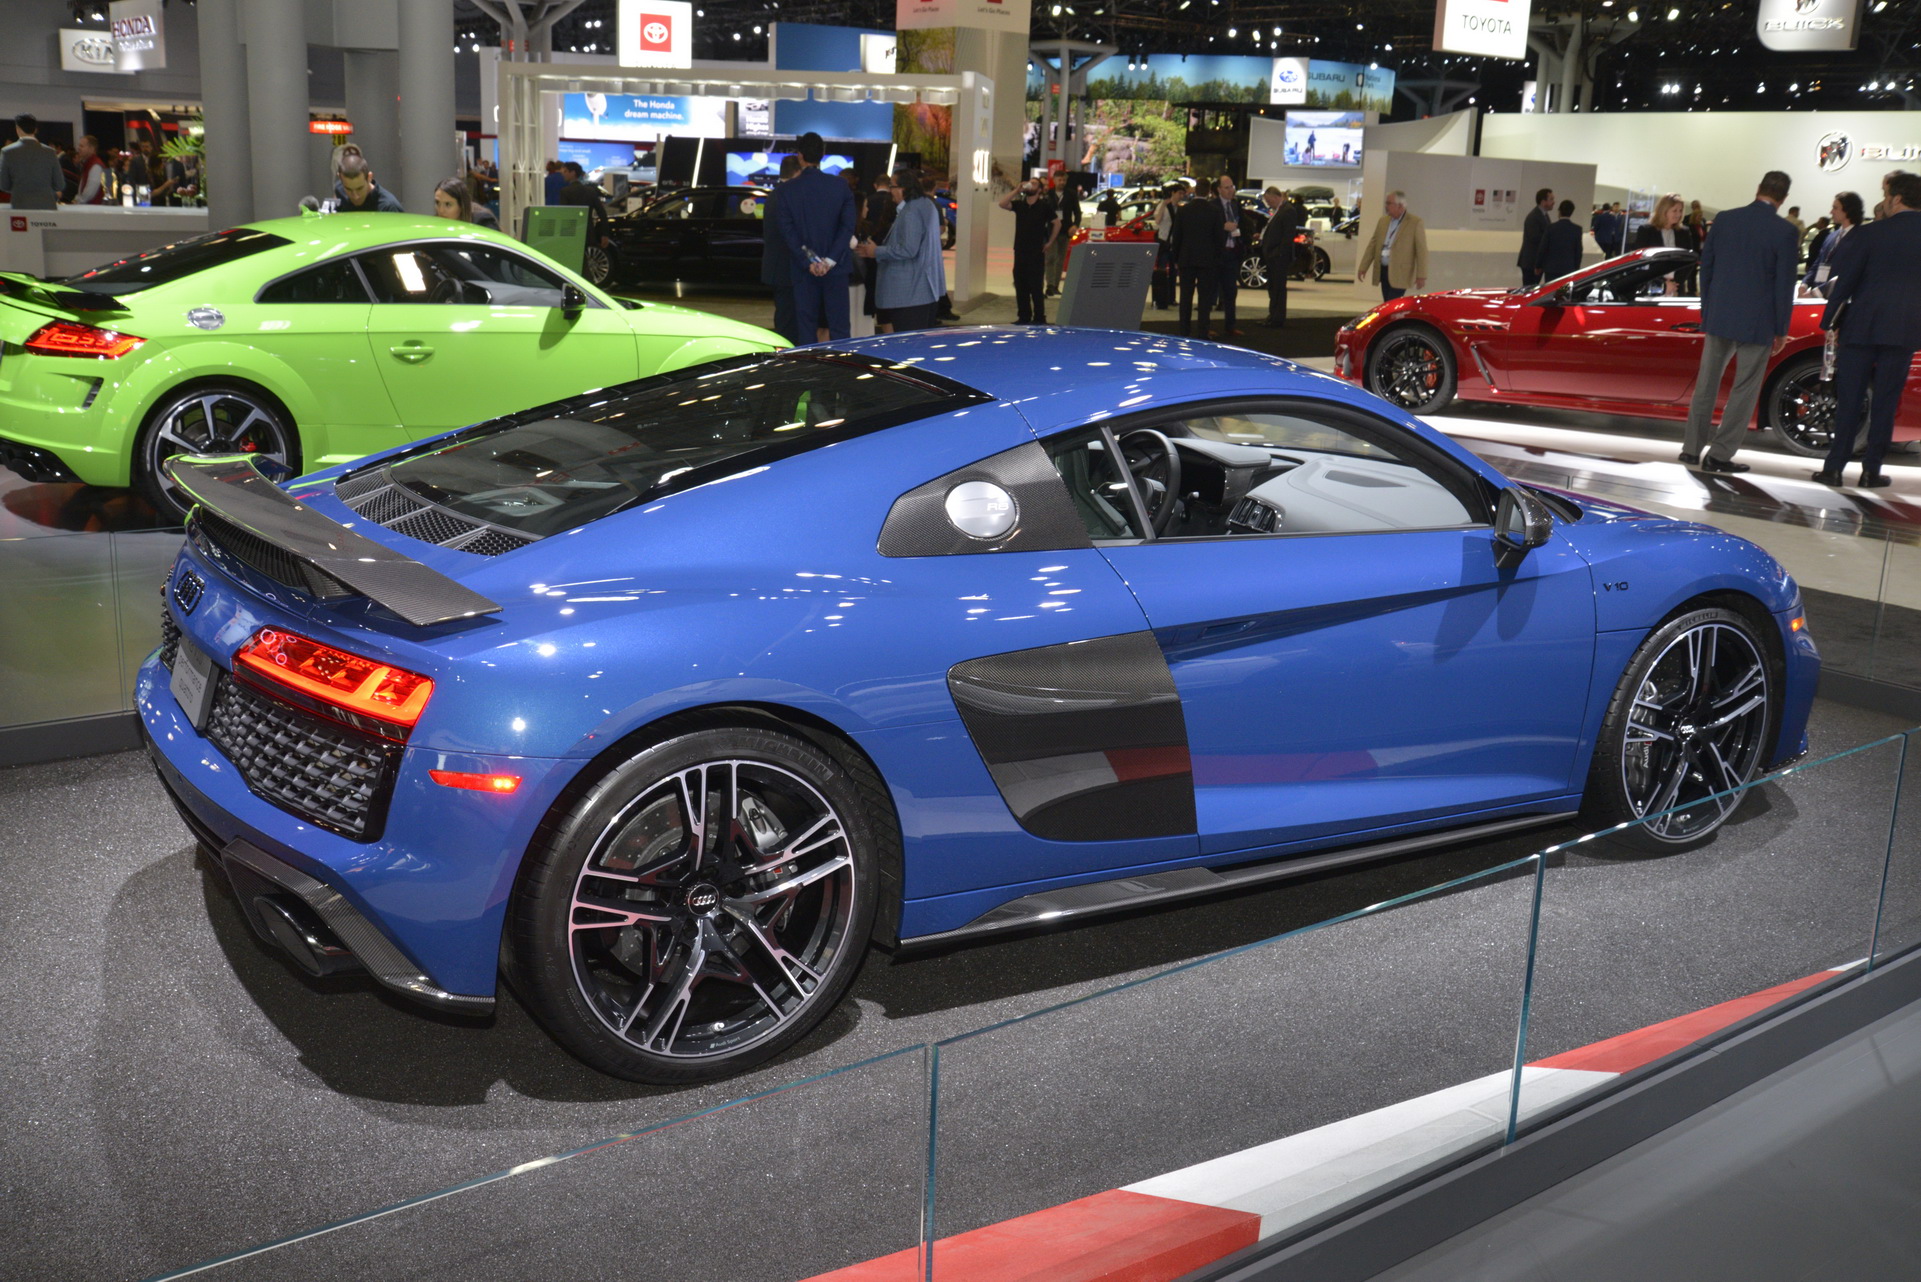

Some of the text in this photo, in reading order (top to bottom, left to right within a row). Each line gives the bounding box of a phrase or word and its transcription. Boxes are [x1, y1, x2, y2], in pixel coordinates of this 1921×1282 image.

[112, 15, 155, 38] HONDA
[1461, 14, 1512, 35] TOYOTA
[1764, 17, 1846, 32] BUICK
[633, 99, 675, 109] The Honda
[624, 110, 684, 120] dream machine.
[986, 502, 1009, 511] R8
[1603, 581, 1629, 592] V10
